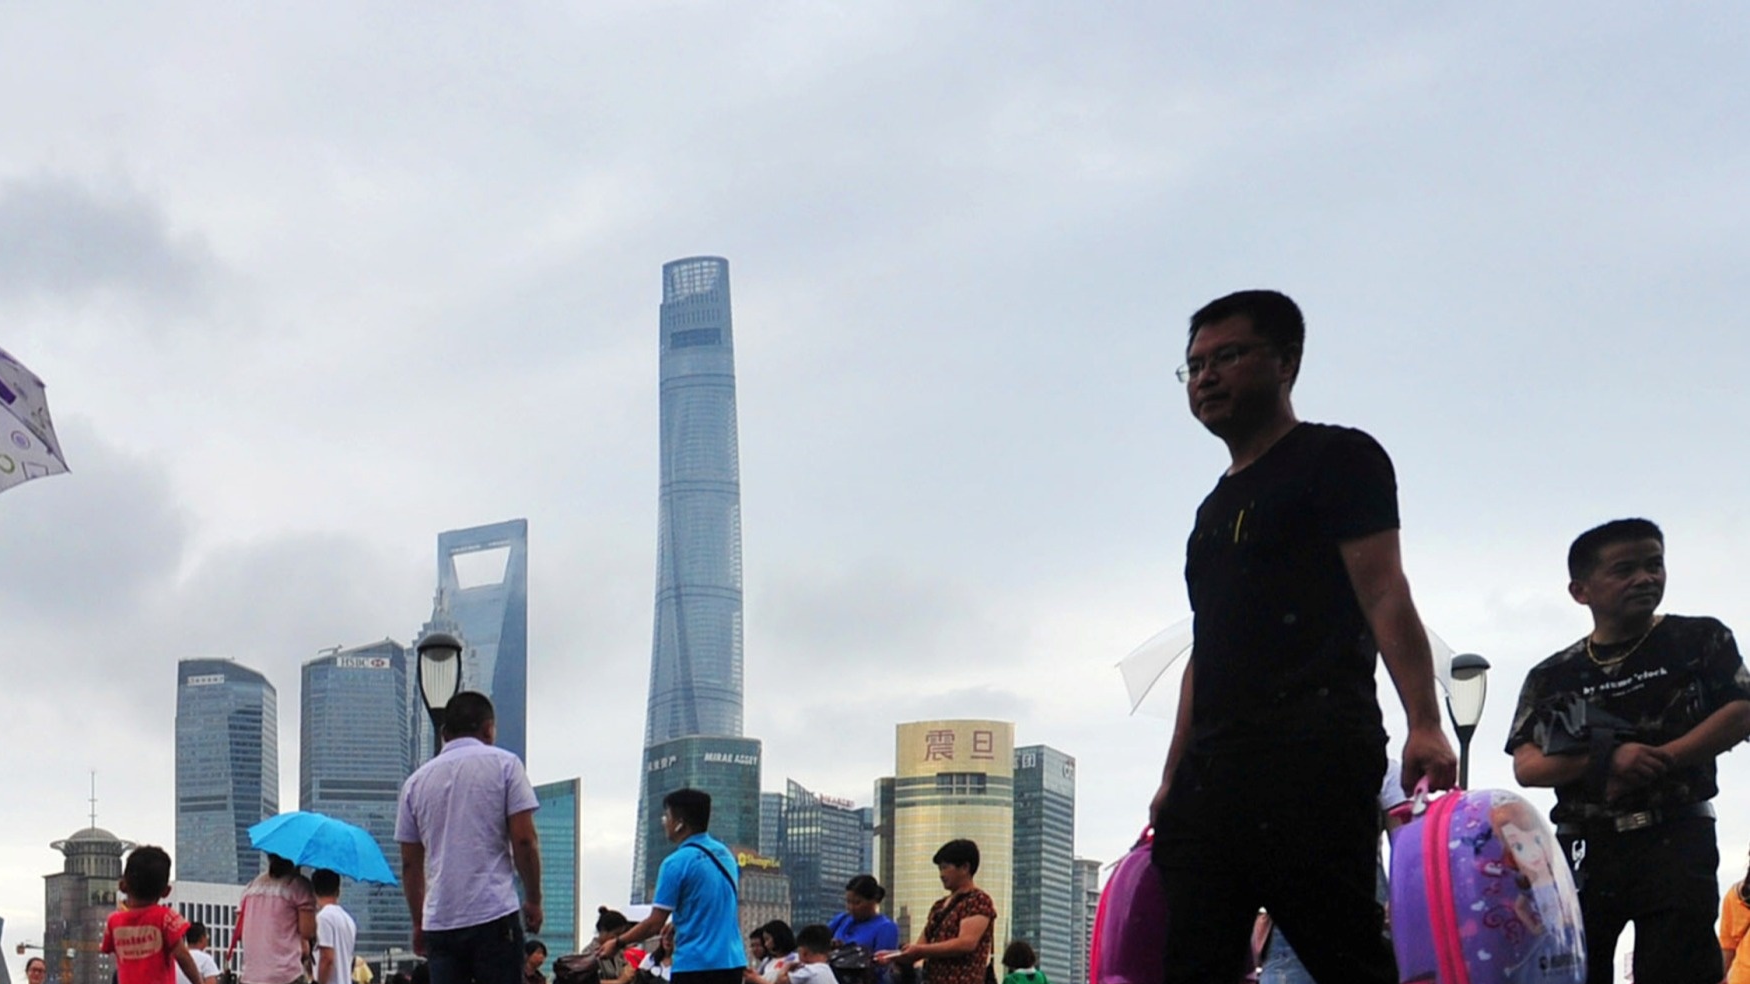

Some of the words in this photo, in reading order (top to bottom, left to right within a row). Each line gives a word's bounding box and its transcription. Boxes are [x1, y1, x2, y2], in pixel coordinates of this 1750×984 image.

[341, 658, 368, 669] HSBC
[925, 729, 994, 762] 震旦
[704, 751, 733, 763] MIRAE
[733, 754, 757, 766] ASSET
